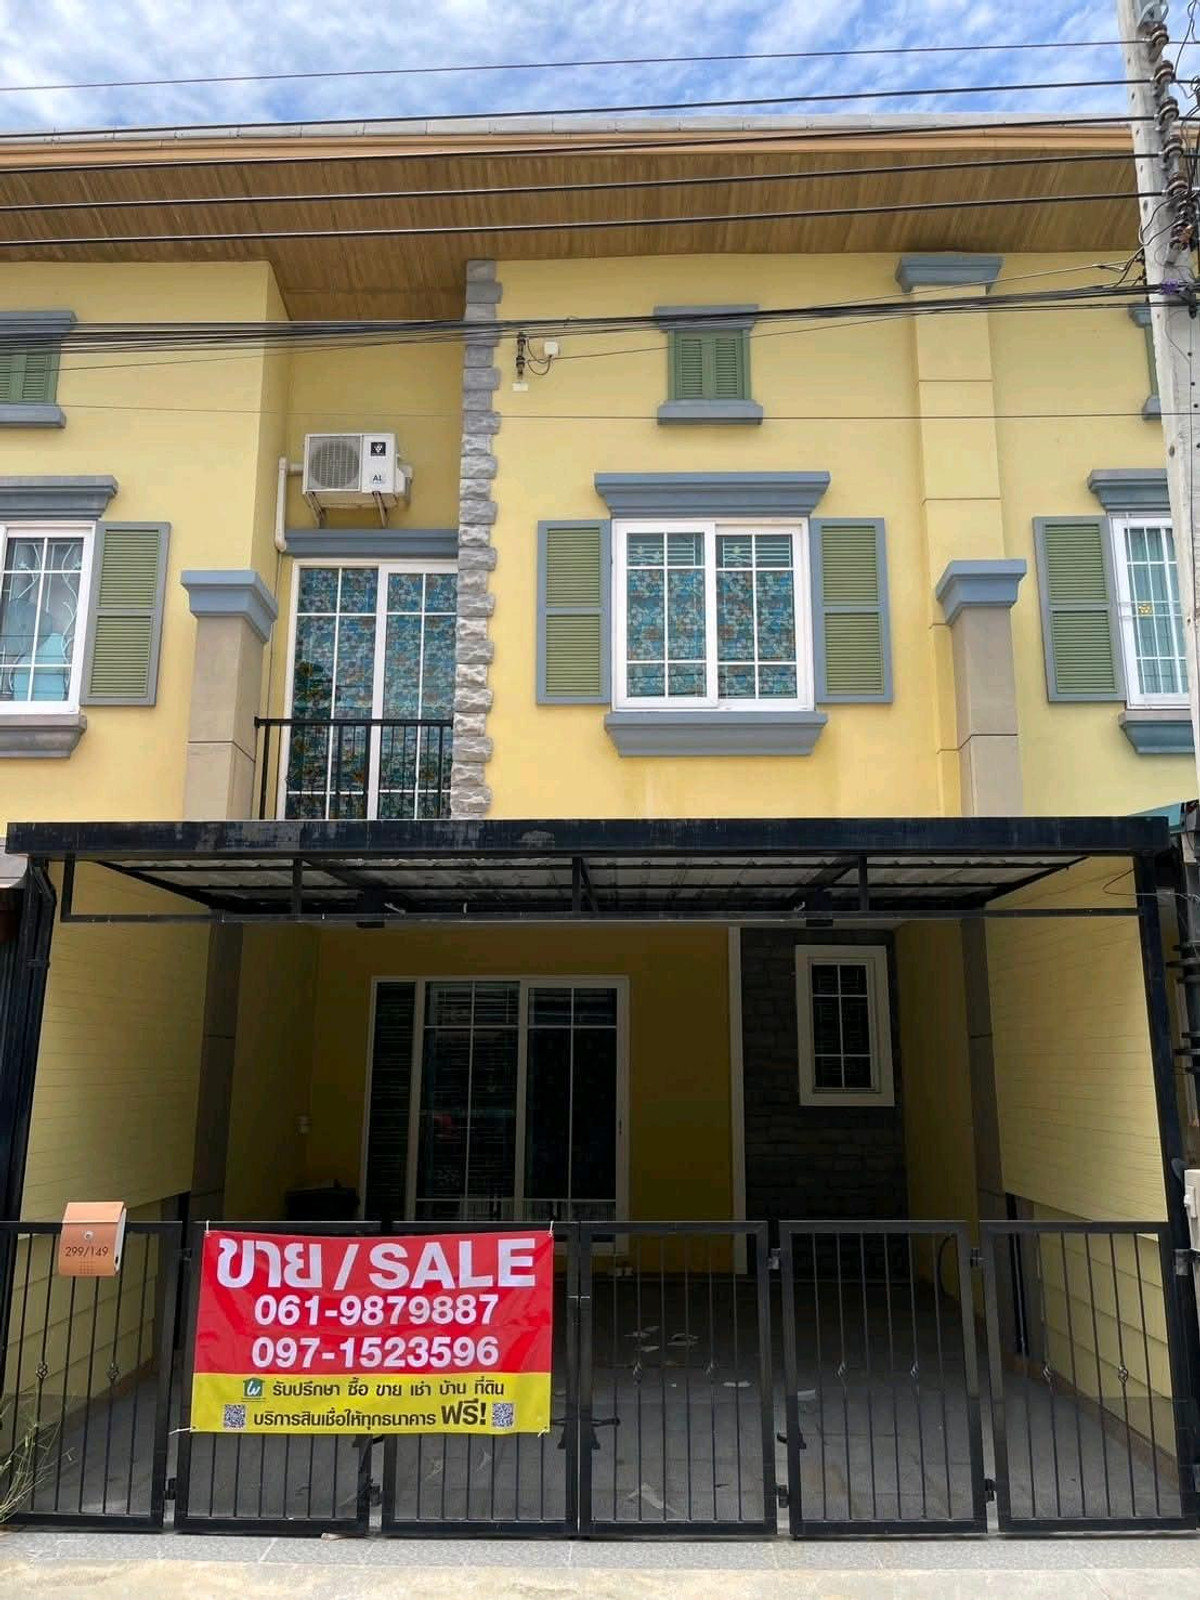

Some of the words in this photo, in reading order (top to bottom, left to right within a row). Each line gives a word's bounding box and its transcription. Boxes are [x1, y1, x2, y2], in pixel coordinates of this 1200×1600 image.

[65, 1245, 109, 1257] 299/149
[216, 1238, 323, 1288] ขาย
[368, 1237, 536, 1289] SALE
[254, 1294, 499, 1326] 061-9879887
[251, 1336, 500, 1369] 097-1523596
[272, 1380, 340, 1397] รับปรึกษา
[347, 1377, 368, 1396] ซื้อ
[376, 1383, 402, 1396] ขาย
[410, 1381, 431, 1396] เช่า
[439, 1380, 466, 1395] บ้าน
[474, 1376, 504, 1395] ที่ดิน
[253, 1407, 436, 1430] บริการสินเชื่อให้ทุกธนาคาร
[441, 1398, 487, 1425] ฟรี!
